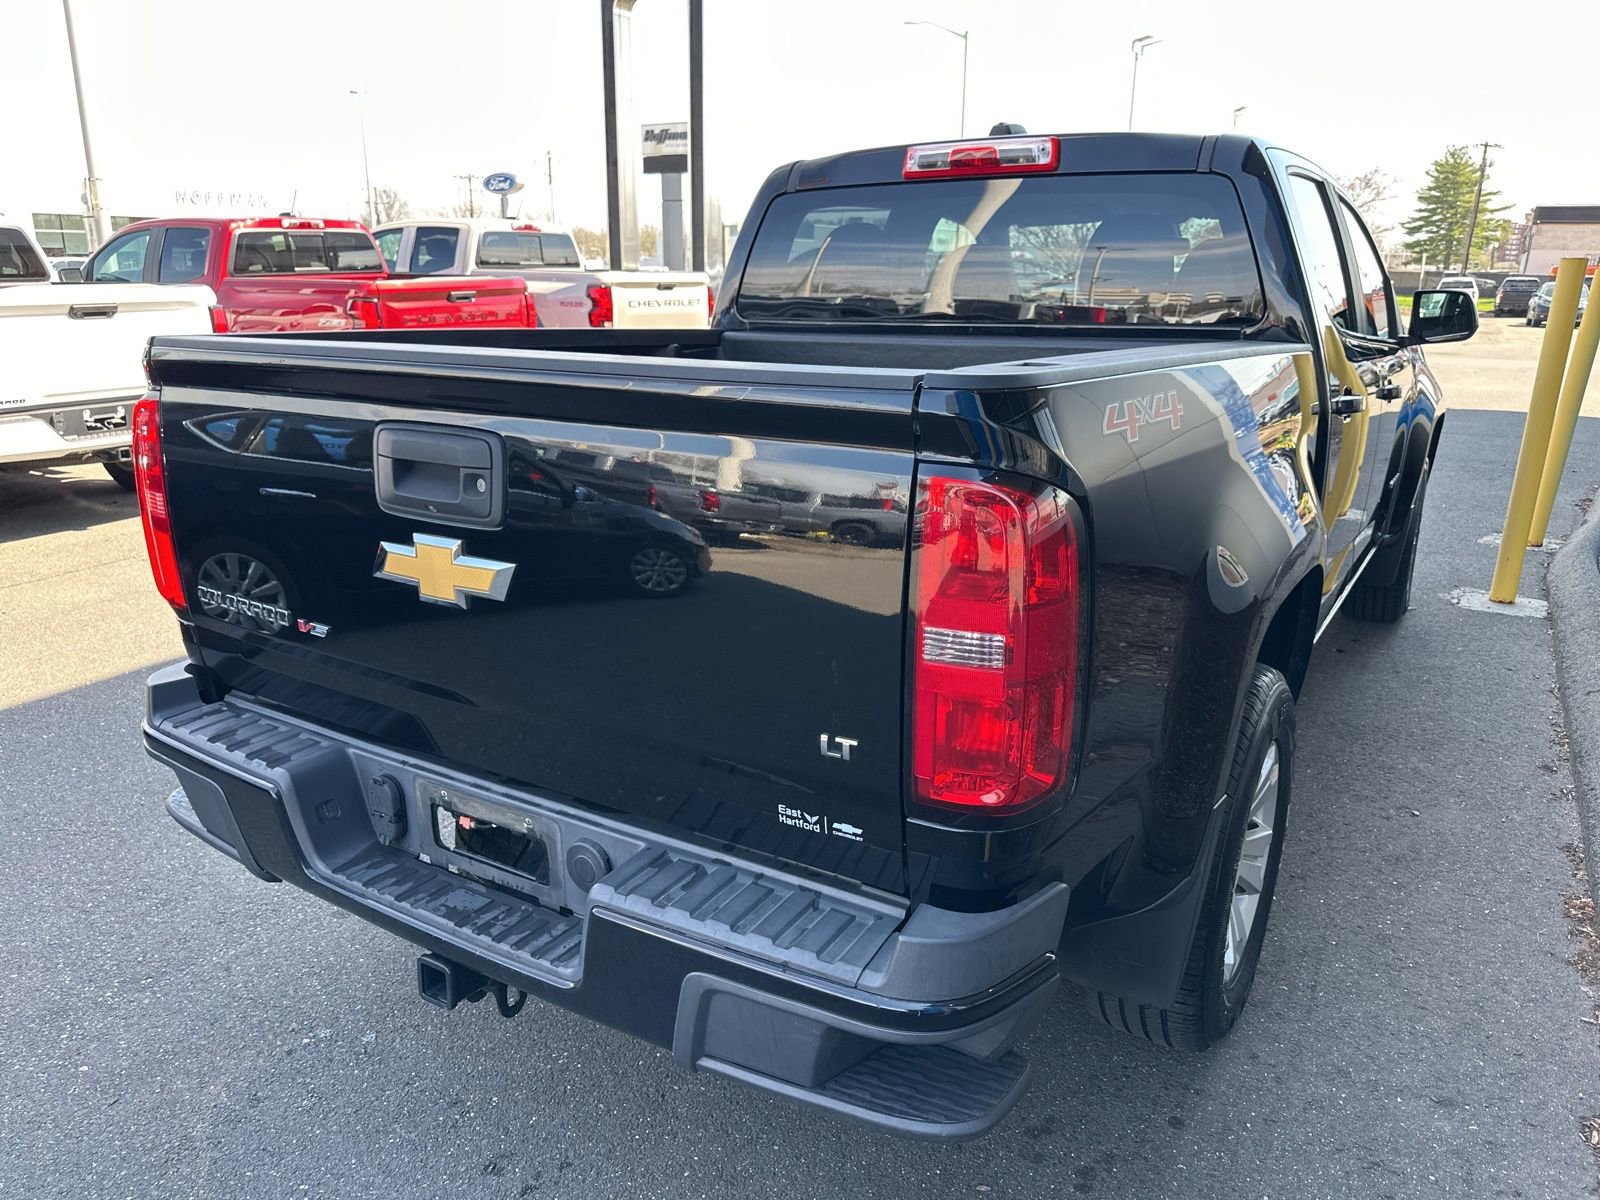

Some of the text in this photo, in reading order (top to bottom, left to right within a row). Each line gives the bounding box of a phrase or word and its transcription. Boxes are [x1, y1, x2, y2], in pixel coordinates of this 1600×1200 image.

[488, 177, 511, 190] Ford
[628, 298, 701, 309] CHEVROLET
[403, 310, 515, 326] CHEVROLET
[197, 585, 290, 627] COLORADO
[820, 733, 859, 761] LT
[778, 804, 802, 818] East
[779, 814, 820, 832] Hartford
[832, 830, 863, 841] CHEVROLET
